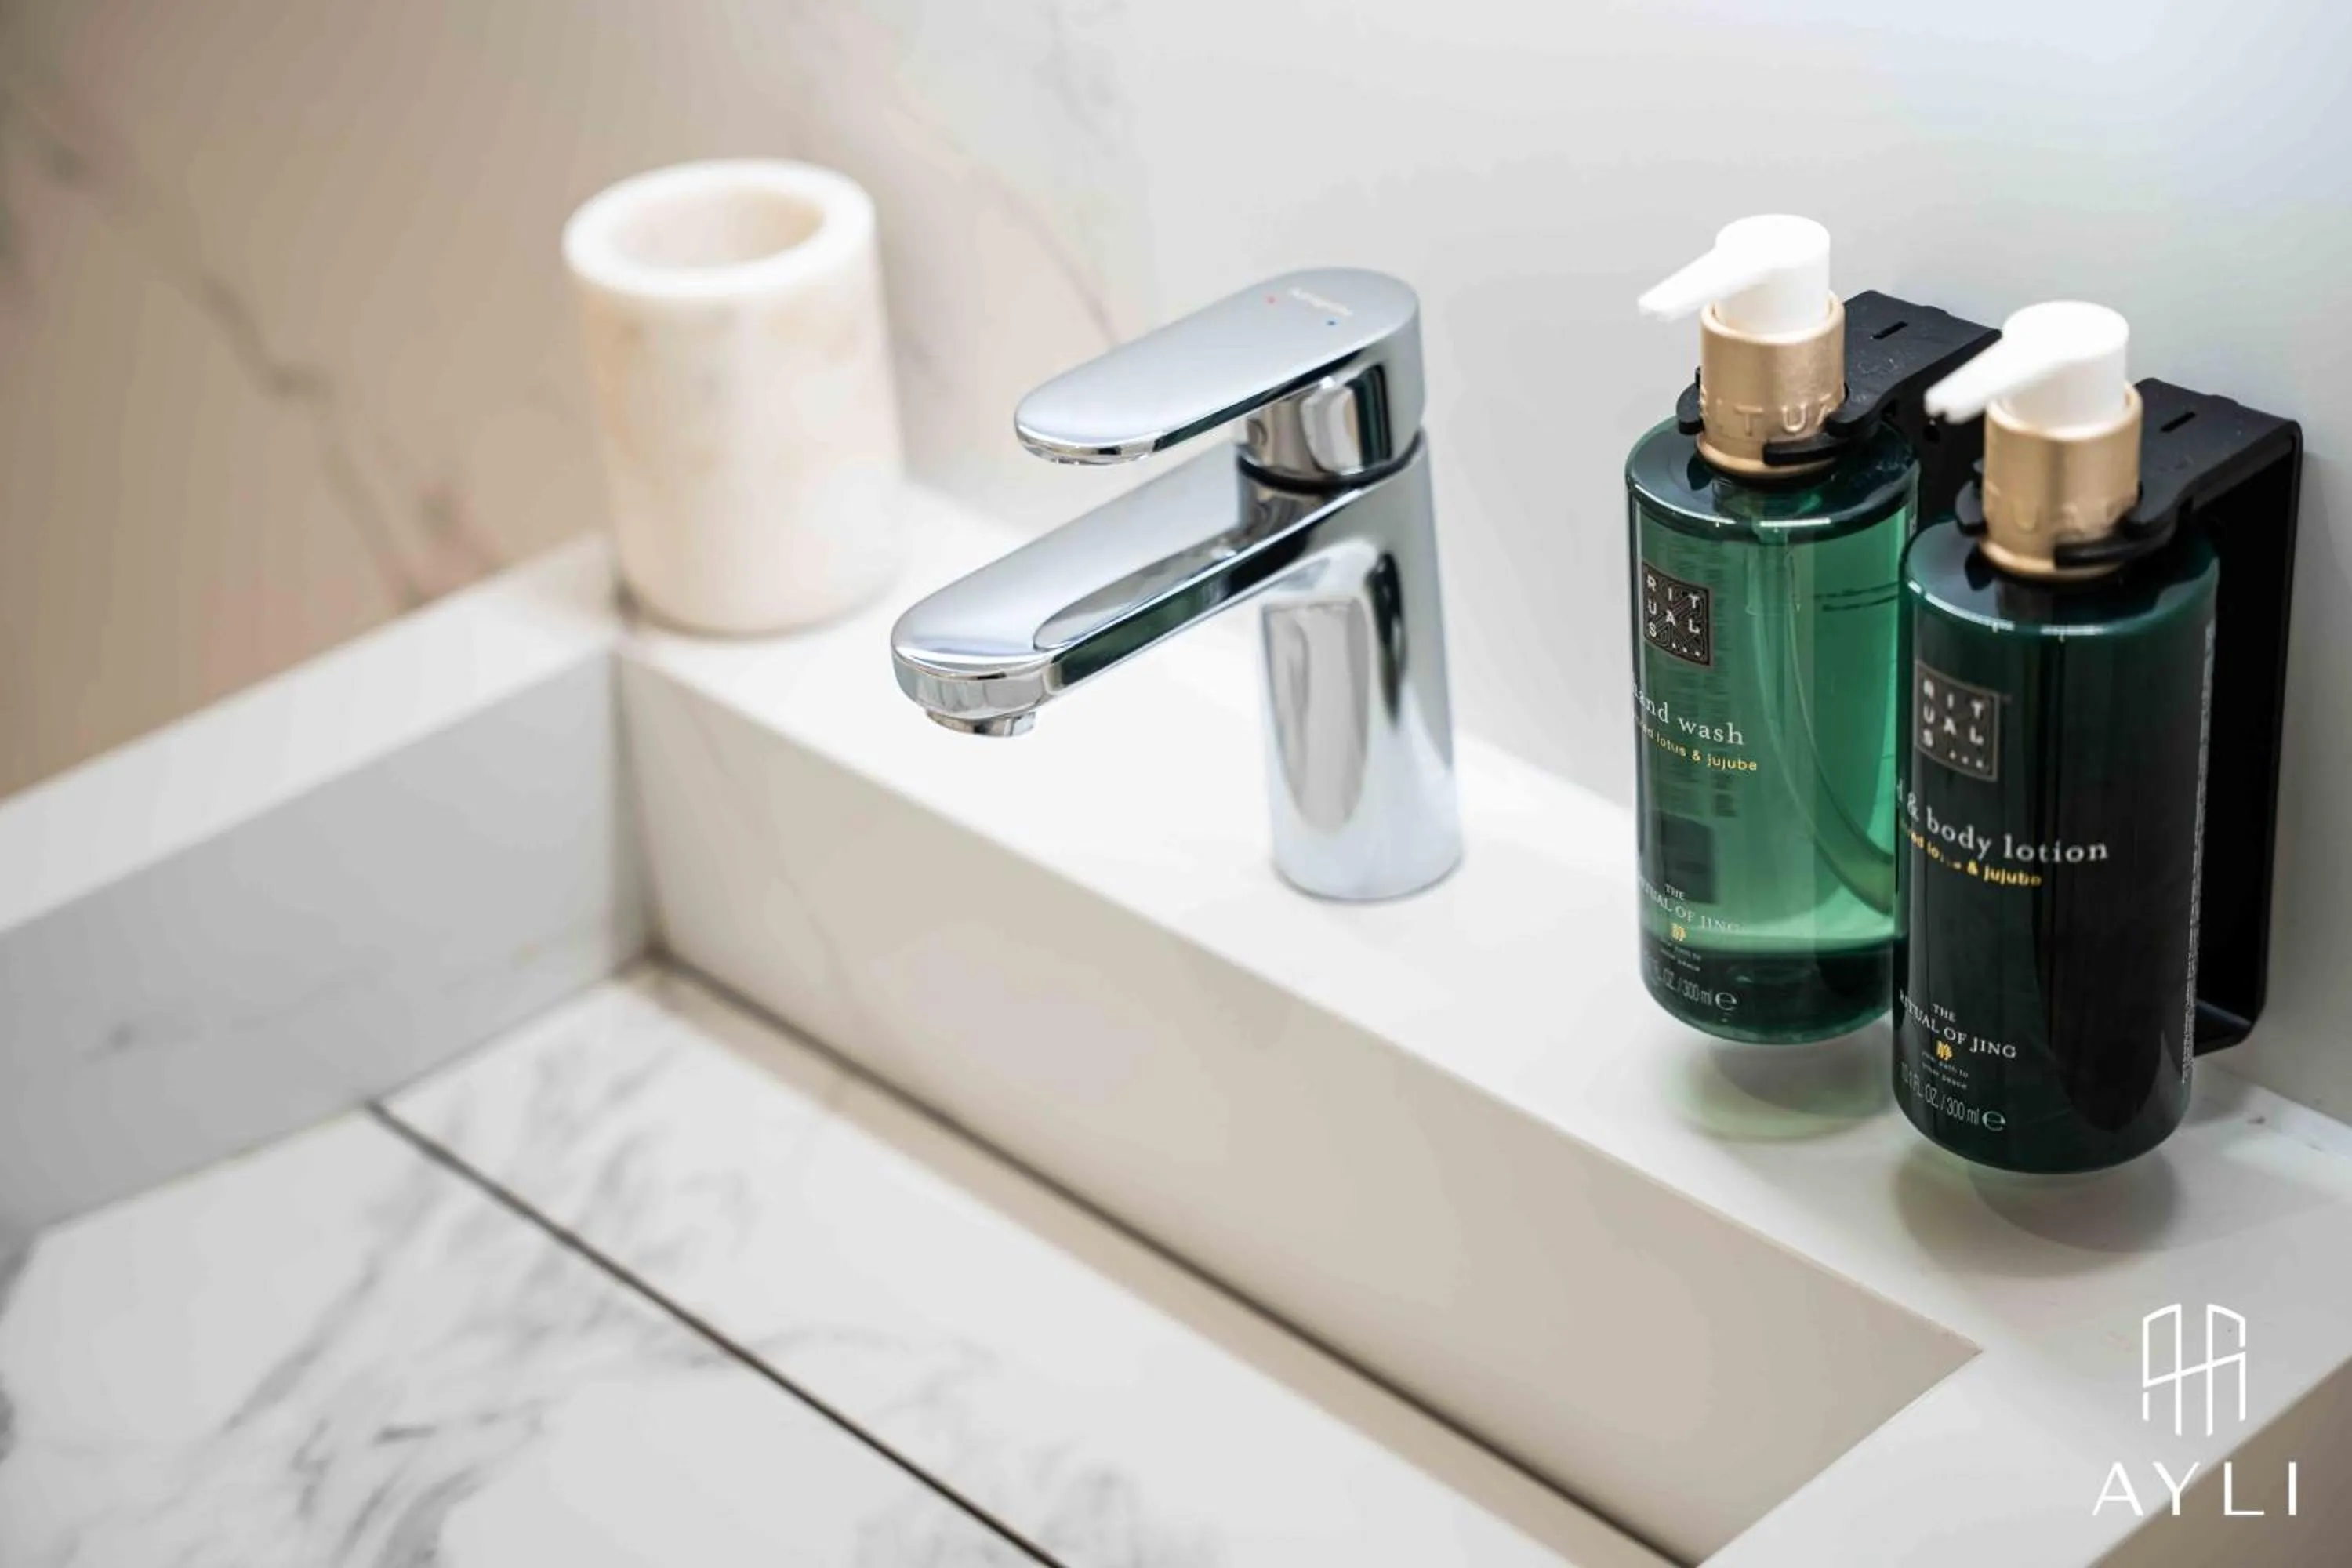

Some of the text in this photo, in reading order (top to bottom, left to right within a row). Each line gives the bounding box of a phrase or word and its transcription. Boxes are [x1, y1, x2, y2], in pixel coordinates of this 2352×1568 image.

[1678, 714, 1744, 745] wash
[1657, 732, 1757, 771] lotus & jujube
[1907, 792, 1919, 821] &
[1926, 805, 1993, 860] body
[2004, 833, 2109, 862] lotion
[1967, 859, 1979, 877] &
[1983, 865, 2042, 887] jujube
[1665, 883, 1685, 901] THE
[1675, 906, 1696, 923] OF
[1682, 979, 1700, 1001] 300
[1933, 1003, 1956, 1023] THE
[1944, 1026, 1967, 1044] OF
[1969, 1036, 2017, 1058] JING
[1947, 1097, 1965, 1120] 300
[1967, 1107, 1980, 1125] ml
